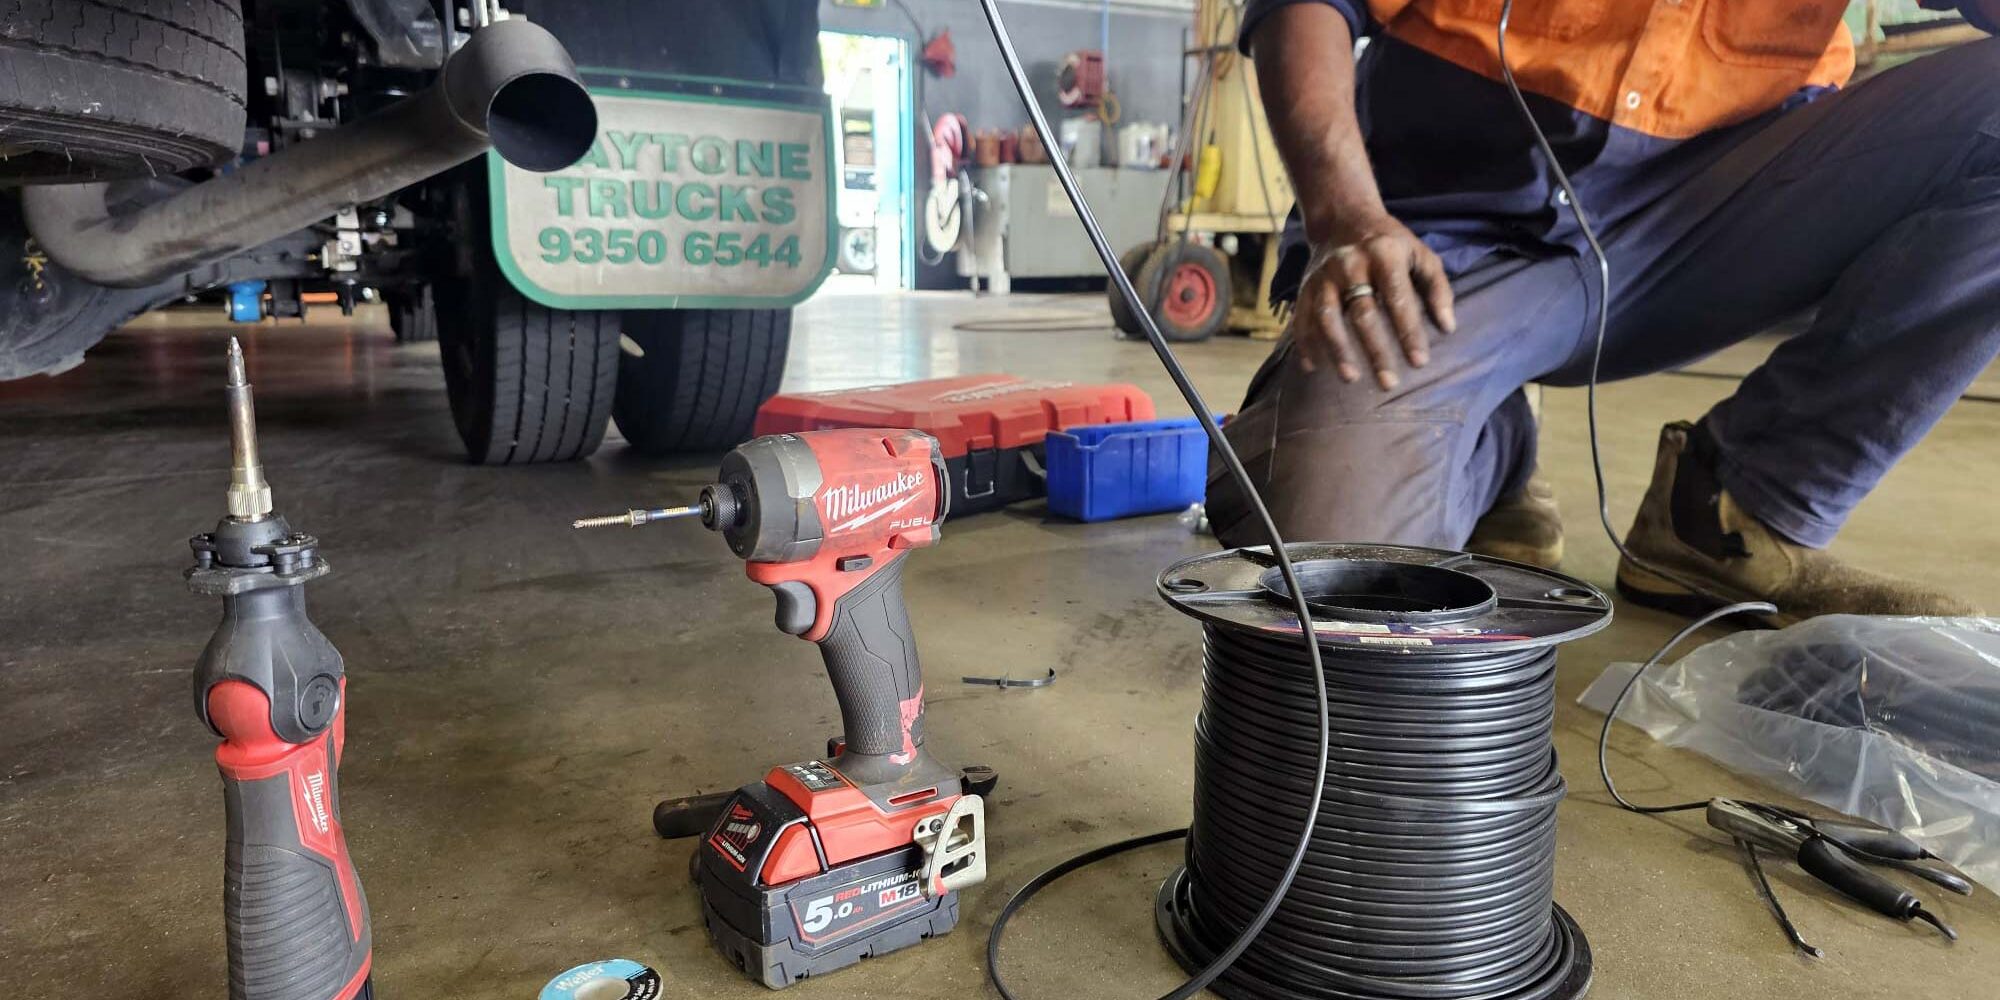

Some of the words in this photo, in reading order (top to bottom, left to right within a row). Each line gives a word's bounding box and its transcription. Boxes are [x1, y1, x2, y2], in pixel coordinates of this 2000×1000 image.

[575, 131, 812, 181] AYTONE
[544, 176, 798, 225] TRUCKS
[538, 226, 668, 265] 9350
[683, 231, 802, 269] 6544
[821, 471, 924, 521] Milwaukee
[889, 516, 932, 530] FUEL
[307, 769, 329, 833] Milwaukee
[803, 895, 853, 933] 5.0
[880, 883, 918, 905] M18
